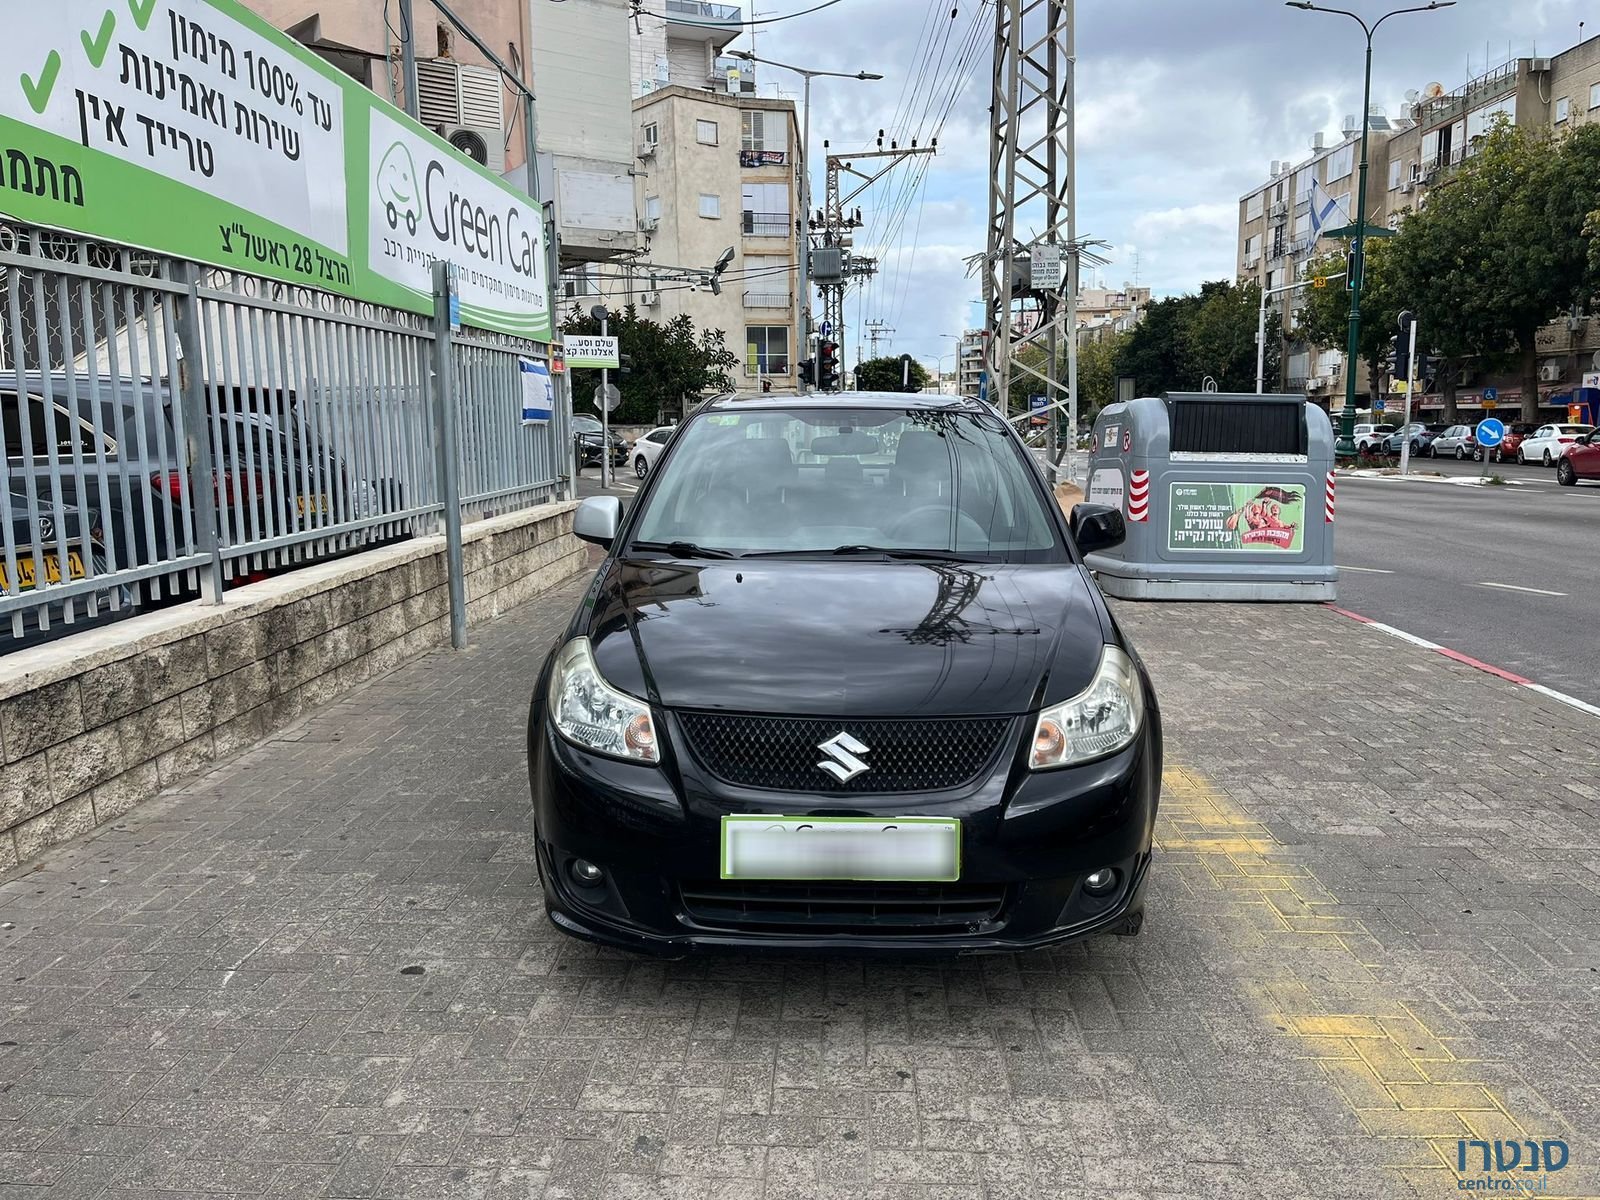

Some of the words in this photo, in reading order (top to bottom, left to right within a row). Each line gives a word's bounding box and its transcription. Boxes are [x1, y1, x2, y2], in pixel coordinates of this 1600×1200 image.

[168, 8, 237, 80] מימון
[118, 43, 228, 130] ואמינות
[243, 50, 304, 117] 100%
[75, 88, 129, 148] אין
[307, 91, 333, 132] עד
[136, 113, 215, 178] טרייד
[233, 100, 300, 161] שירות
[425, 159, 504, 266] Green
[506, 207, 538, 279] Car
[292, 243, 313, 275] 28
[383, 237, 404, 261] רכב
[316, 248, 350, 286] הרצל
[1315, 278, 1325, 287] 13
[580, 348, 589, 356] זה
[591, 348, 614, 357] אצלנו
[595, 339, 614, 348] שלם
[1174, 530, 1205, 543] נקייה!
[1184, 518, 1224, 530] שומרים
[1207, 529, 1233, 543] עליה
